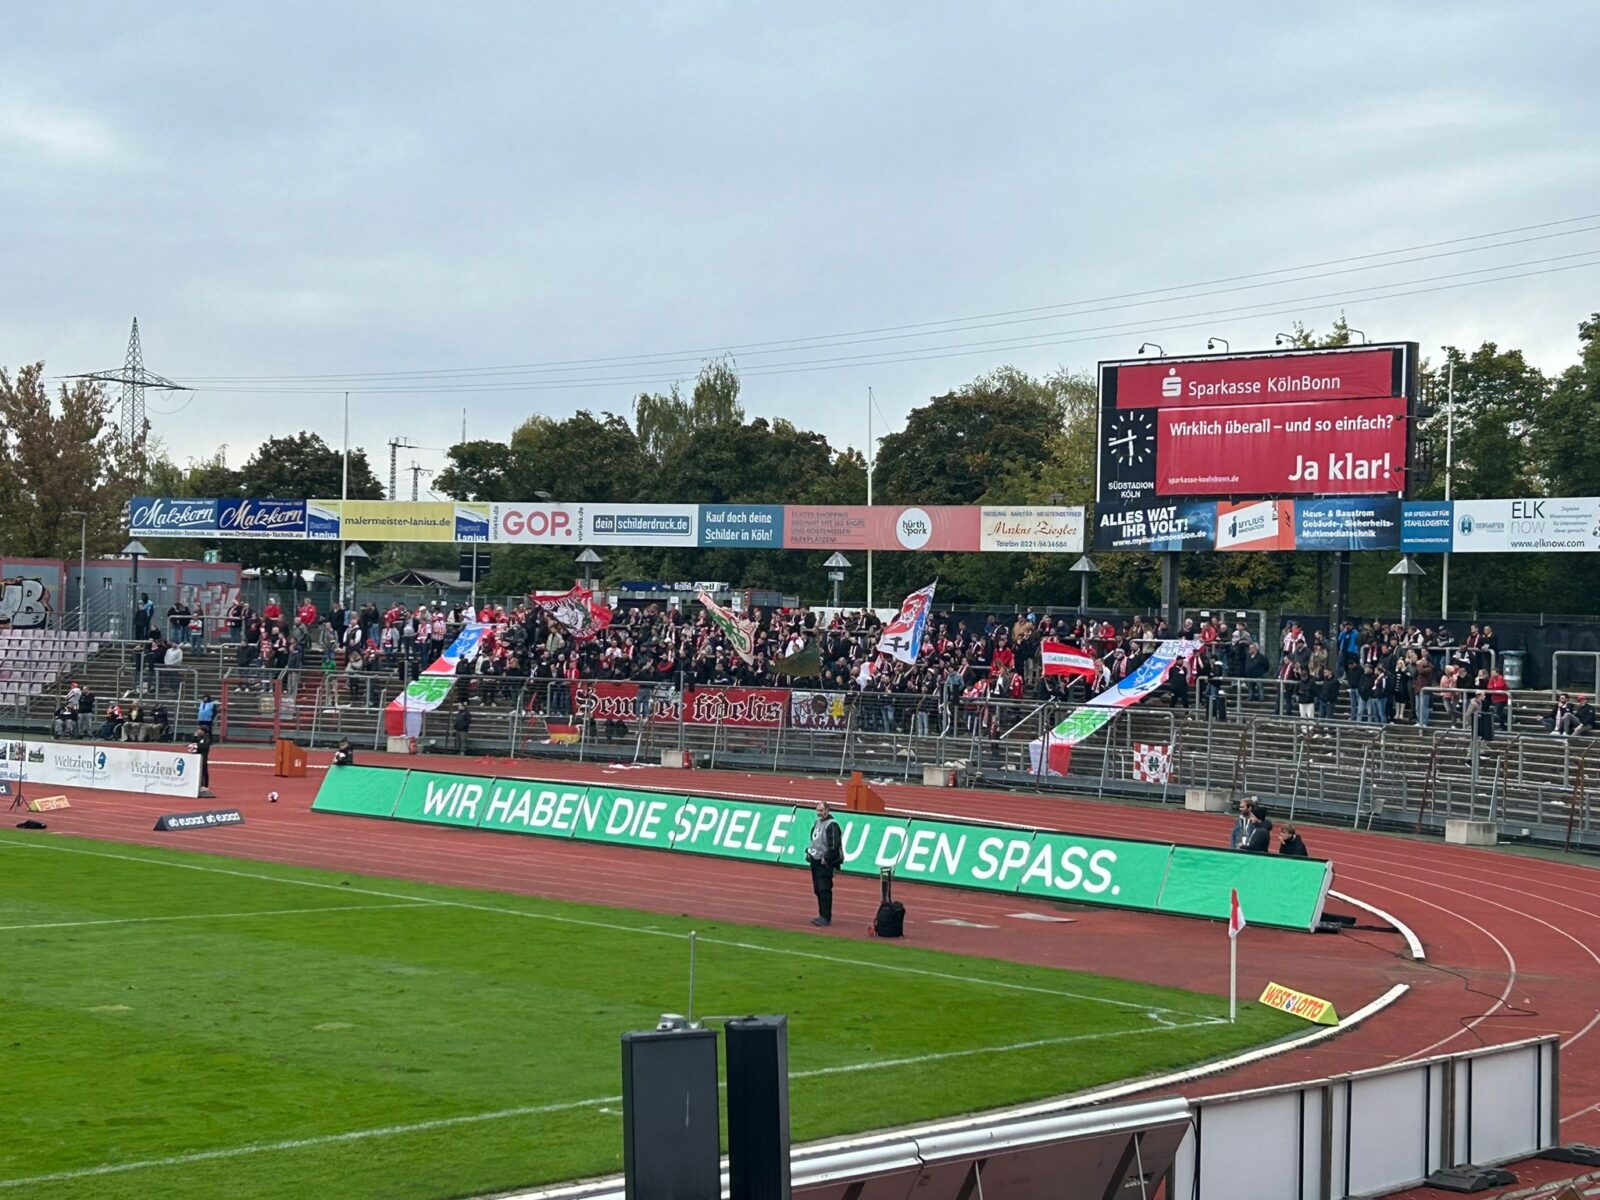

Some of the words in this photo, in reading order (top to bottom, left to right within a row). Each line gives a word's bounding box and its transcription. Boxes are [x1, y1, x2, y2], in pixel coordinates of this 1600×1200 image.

[1188, 380, 1261, 397] Sparkasse
[1267, 375, 1341, 392] KölnBonn
[1169, 421, 1222, 437] Wirklich
[1225, 418, 1270, 433] überall
[1285, 416, 1310, 432] und
[1314, 419, 1330, 431] so
[1335, 415, 1393, 431] einfach?
[1288, 455, 1319, 481] Ja
[1328, 453, 1391, 480] klar!
[1108, 481, 1154, 490] SÜDSTADION
[1121, 490, 1141, 498] KÖLN
[132, 499, 215, 528] Malzkorn
[219, 500, 304, 529] Malzkorn
[1100, 510, 1144, 527] ALLES
[1147, 506, 1177, 522] WAT
[1302, 510, 1326, 518] Haus-
[1335, 509, 1375, 517] Baustrom
[1512, 501, 1546, 519] ELK
[344, 517, 451, 527] malermeister-lanius.de
[502, 510, 573, 536] GOP.
[595, 517, 613, 529] dein
[617, 517, 688, 530] schilderdruck.de
[706, 511, 725, 523] Kauf
[727, 511, 748, 523] doch
[749, 512, 772, 523] deine
[1344, 519, 1394, 527] Sicherheits-
[902, 519, 925, 530] hürth
[1122, 523, 1146, 538] IHR
[1150, 518, 1188, 534] VOLT!
[1510, 521, 1546, 534] now
[457, 533, 487, 542] Lanius
[705, 529, 739, 541] Schilder
[741, 529, 749, 541] in
[751, 528, 773, 541] Köln!
[907, 527, 927, 537] park
[1302, 529, 1377, 538] Multimediatechnik
[1510, 539, 1585, 548] www.elknow.com
[575, 688, 687, 720] Semer
[54, 755, 93, 769] Weltzien
[131, 760, 173, 776] Weltzien
[423, 780, 484, 820] WIR
[485, 787, 603, 833] HABEN
[605, 798, 669, 840] DIE
[667, 804, 796, 855] SPIELE.
[875, 825, 967, 876] DEN
[971, 835, 1121, 896] SPASS.
[1263, 985, 1291, 1009] WEST
[1291, 994, 1324, 1019] LOTTO
